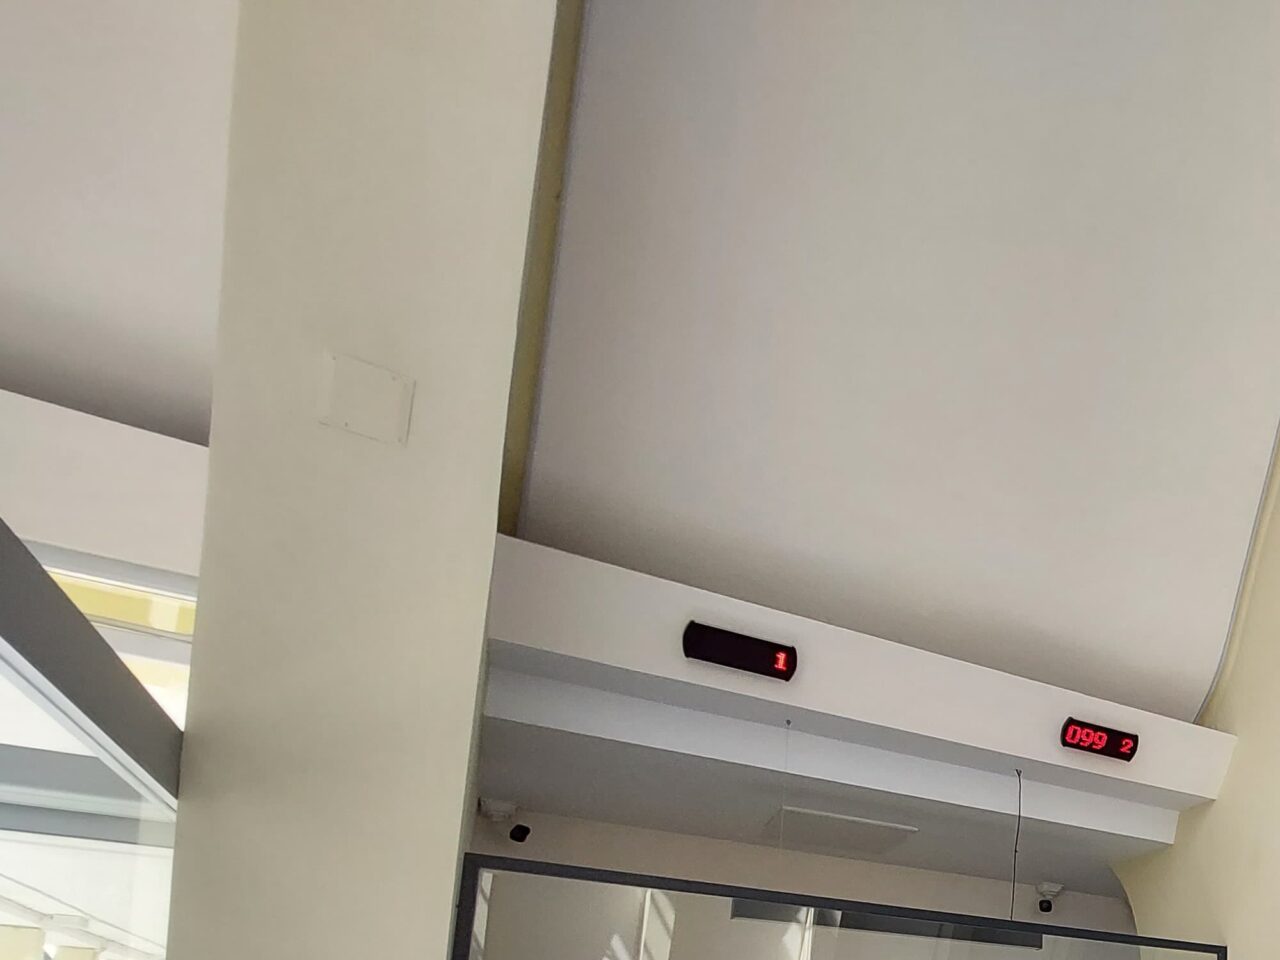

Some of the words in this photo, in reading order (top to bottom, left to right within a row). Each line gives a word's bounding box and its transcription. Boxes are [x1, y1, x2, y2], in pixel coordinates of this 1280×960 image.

[775, 652, 786, 670] 1
[1065, 725, 1108, 749] 099
[1119, 738, 1134, 753] 2
